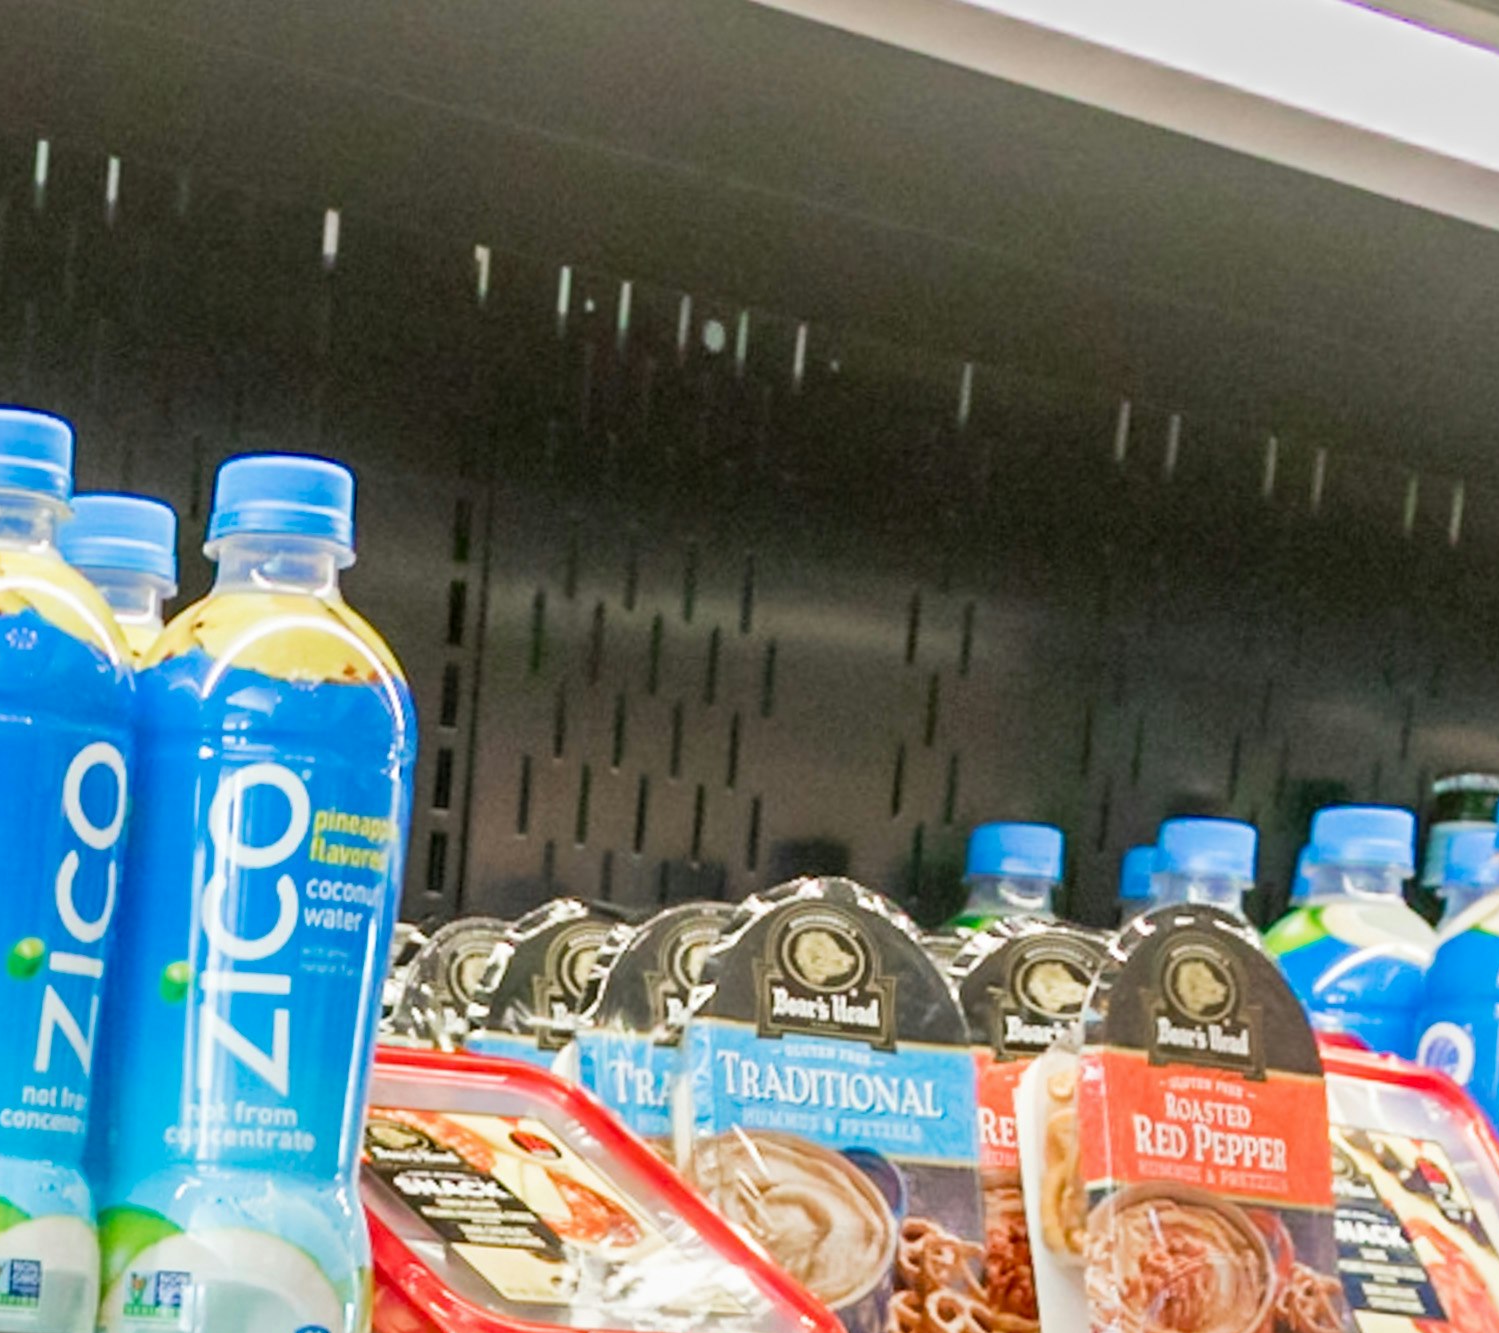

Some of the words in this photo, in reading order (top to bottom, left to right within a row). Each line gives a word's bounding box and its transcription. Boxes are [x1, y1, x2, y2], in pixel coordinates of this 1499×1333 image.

[34, 741, 127, 1077] ZICO
[197, 761, 312, 1099] ZICO
[303, 906, 364, 933] water
[22, 1085, 55, 1107] not
[717, 1049, 944, 1119] TRADITIONAL
[234, 1100, 298, 1127] from
[1164, 1091, 1253, 1129] ROASTED
[1132, 1113, 1187, 1158] RED
[1192, 1122, 1288, 1173] PEPPER
